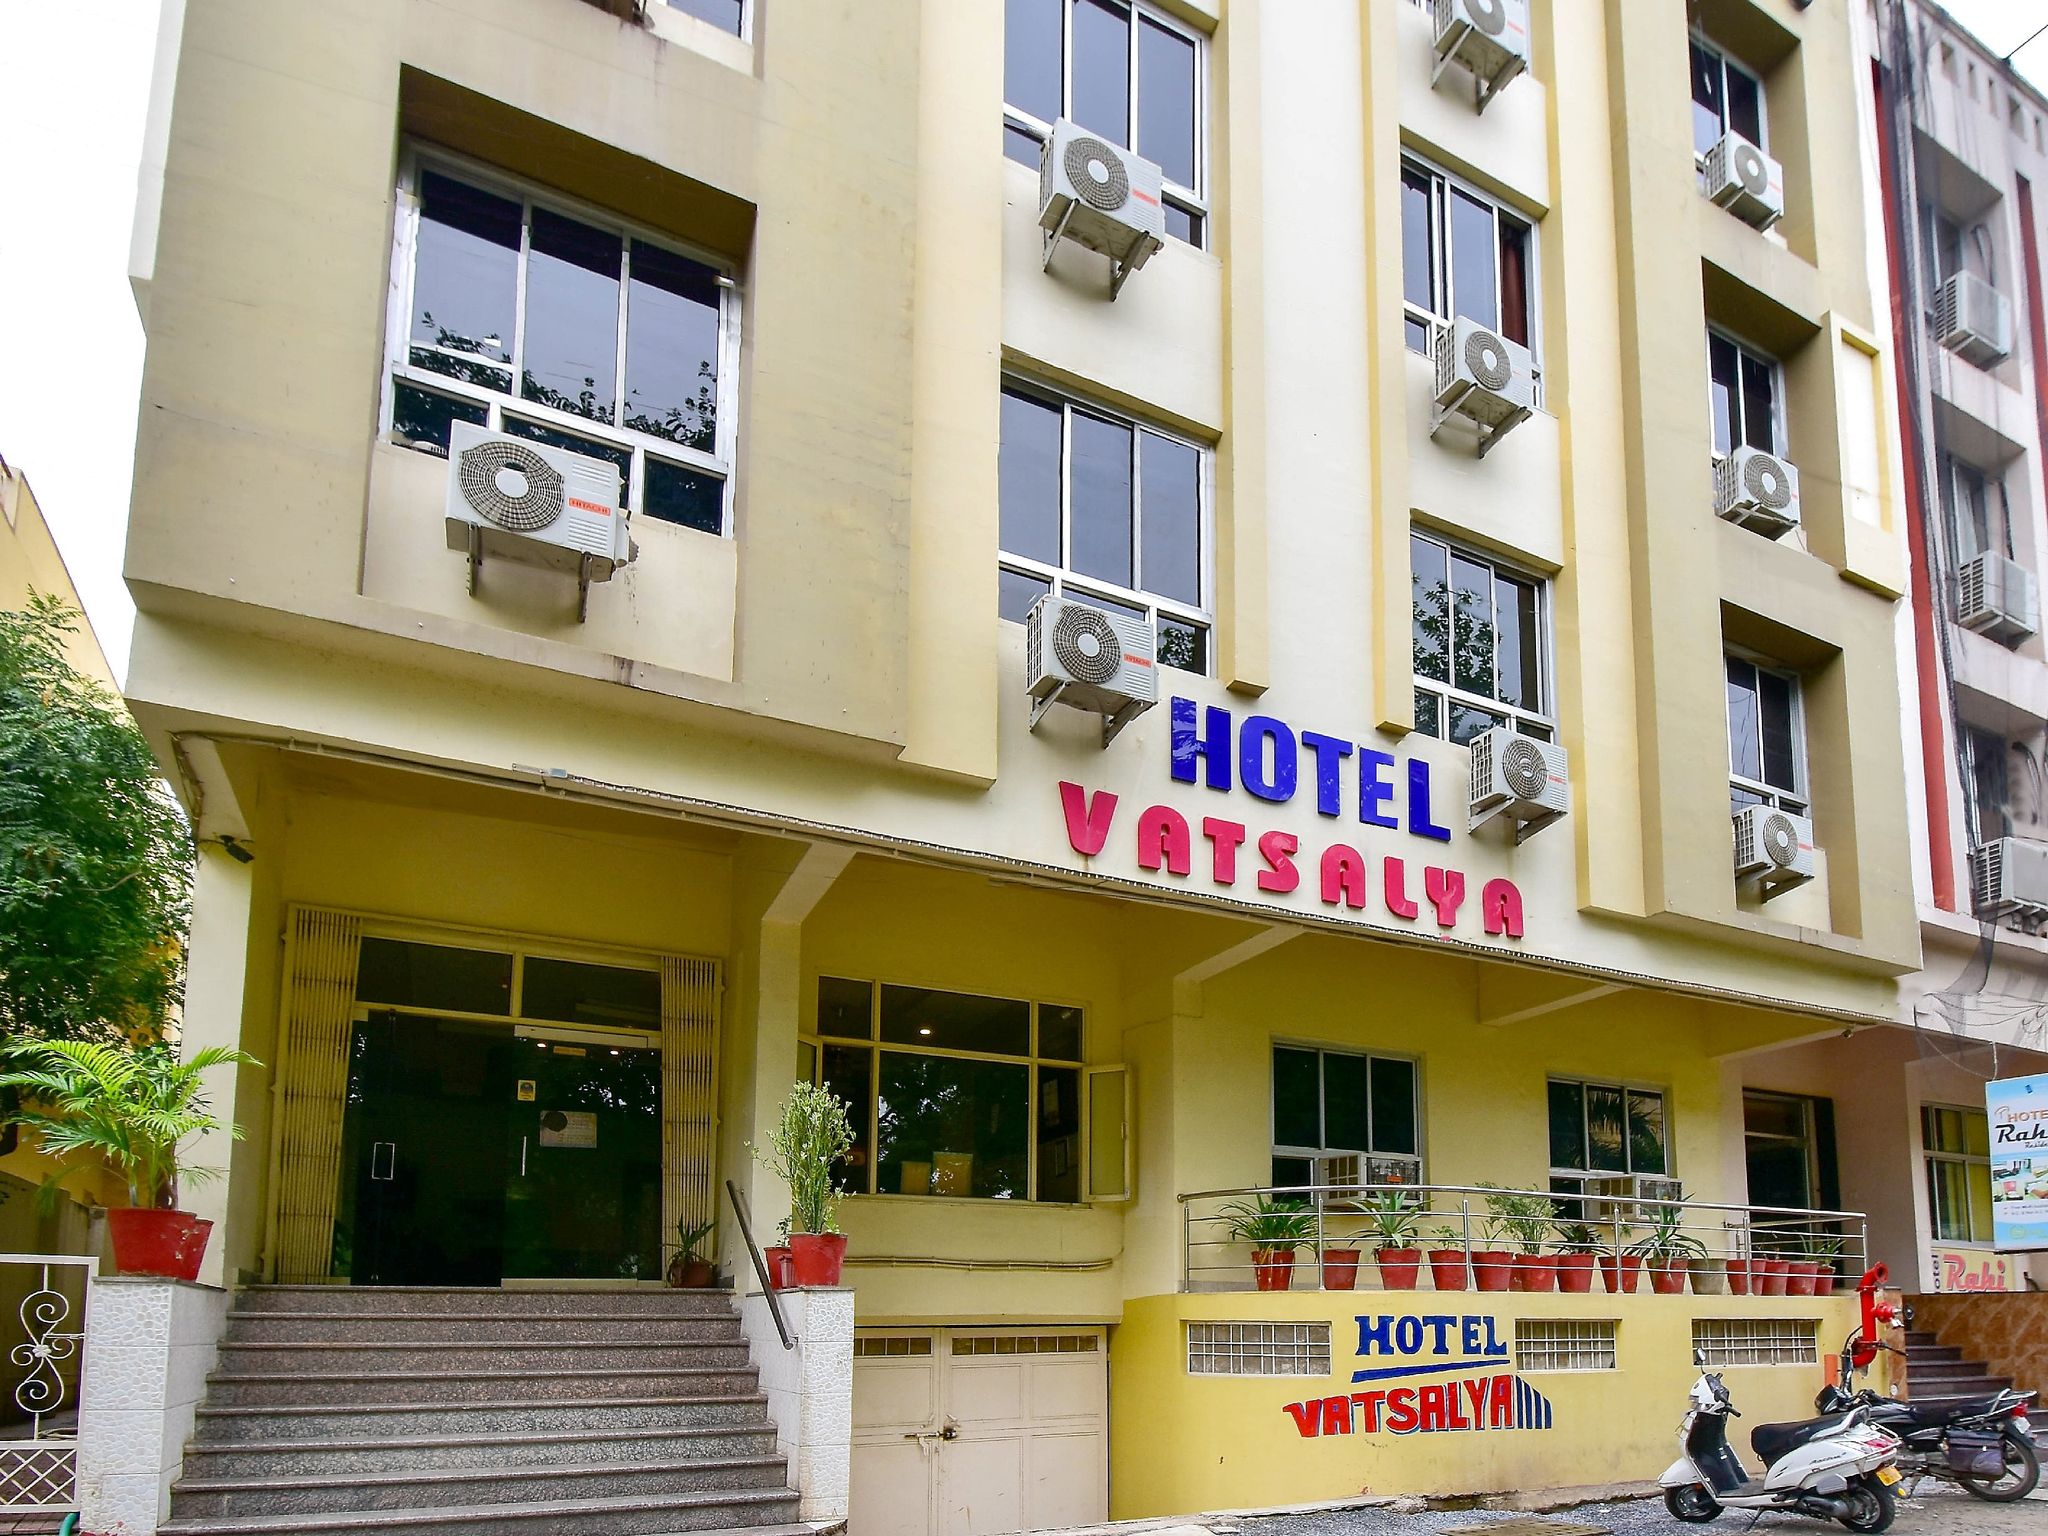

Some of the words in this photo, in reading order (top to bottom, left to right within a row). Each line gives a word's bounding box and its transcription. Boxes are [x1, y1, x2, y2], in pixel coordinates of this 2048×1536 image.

[1171, 695, 1451, 842] HOTEL
[1058, 780, 1524, 939] VATSALYA
[1943, 1254, 2008, 1292] Rahi
[1355, 1315, 1507, 1355] HOTEL
[1282, 1374, 1516, 1438] VATSALYA
